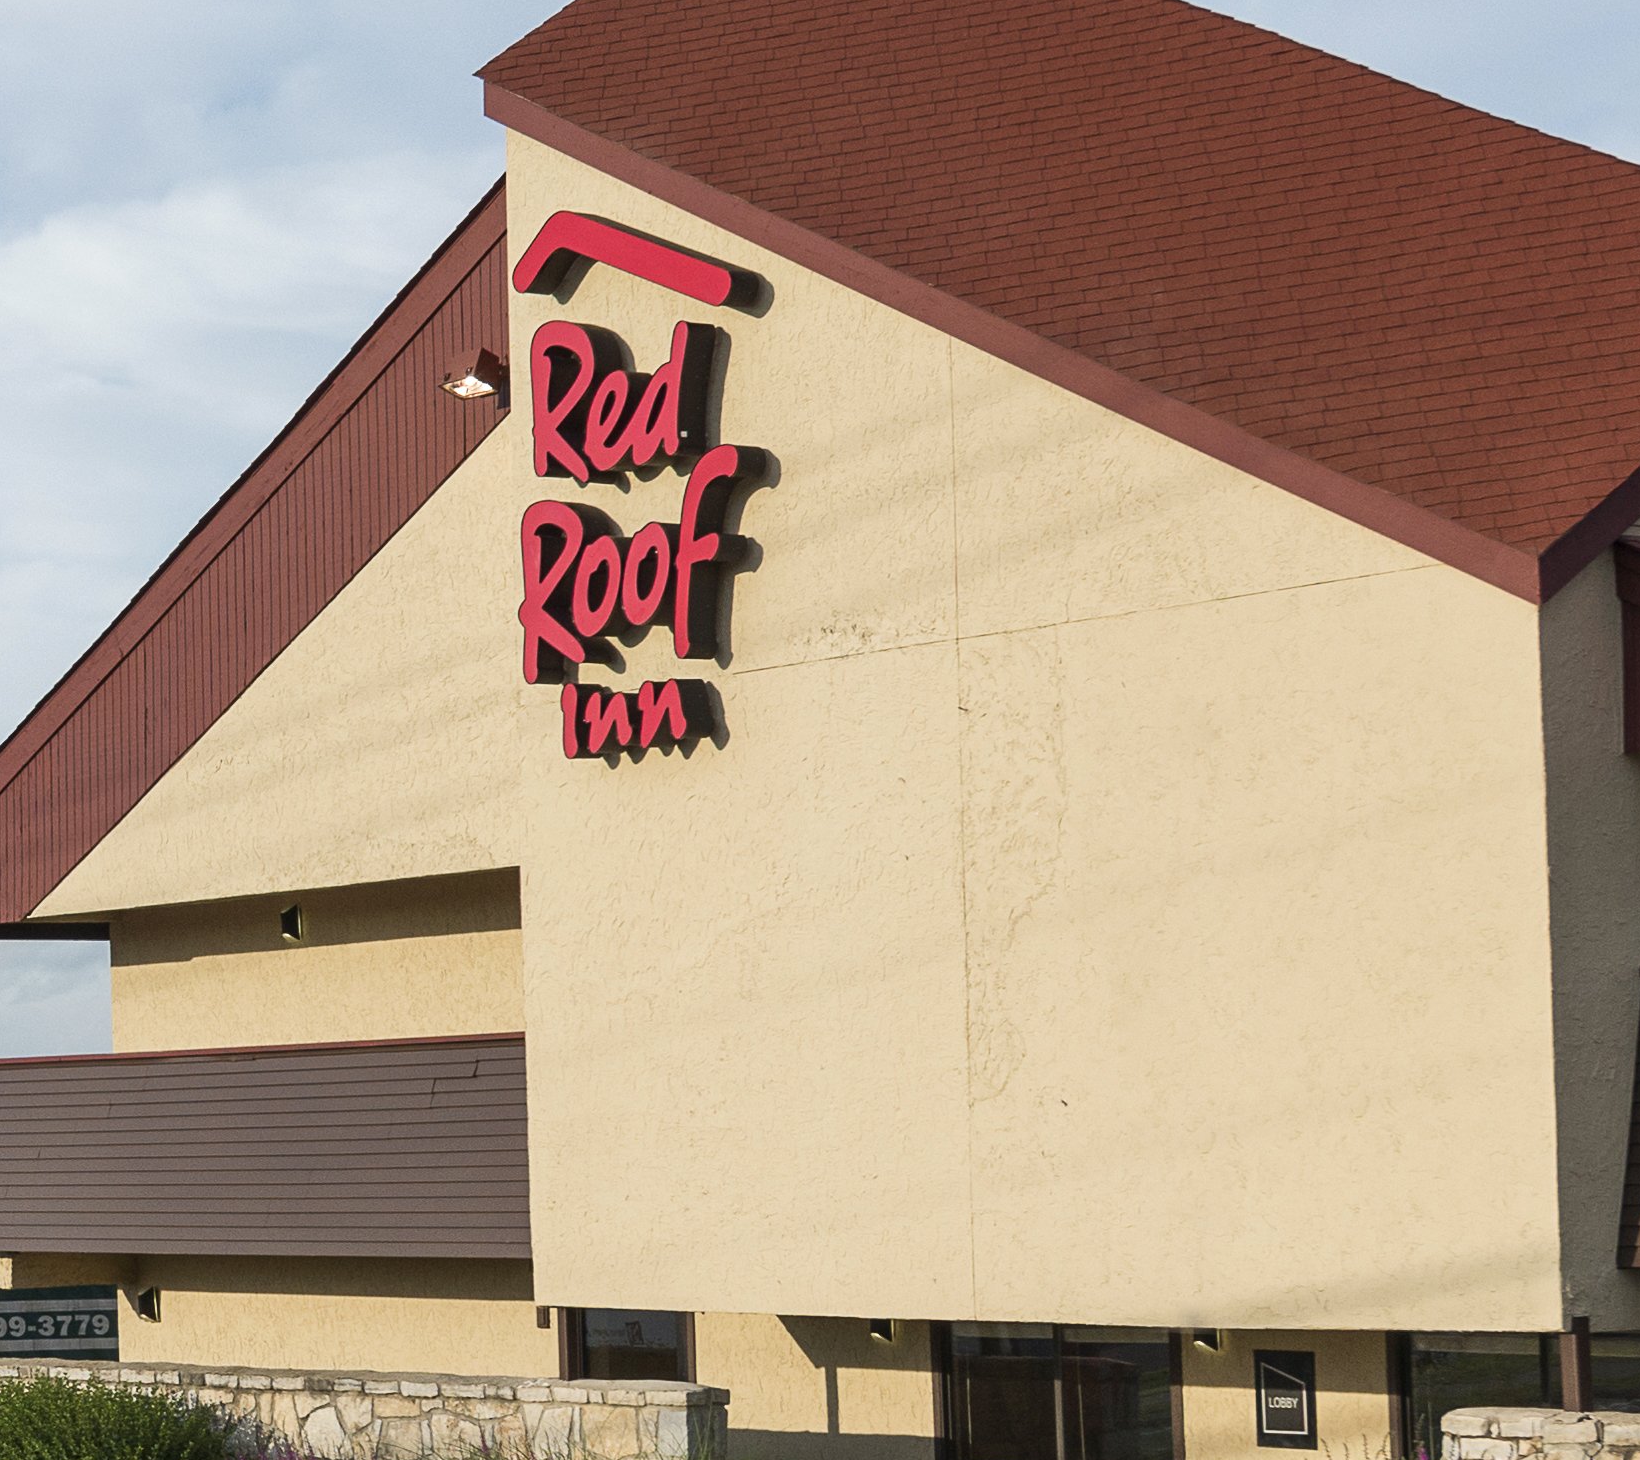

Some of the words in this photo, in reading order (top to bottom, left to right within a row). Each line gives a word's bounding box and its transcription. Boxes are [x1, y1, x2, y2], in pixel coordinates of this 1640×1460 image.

[530, 320, 689, 484] Red
[518, 444, 739, 685] Roof
[1268, 1397, 1299, 1409] LOBBY
